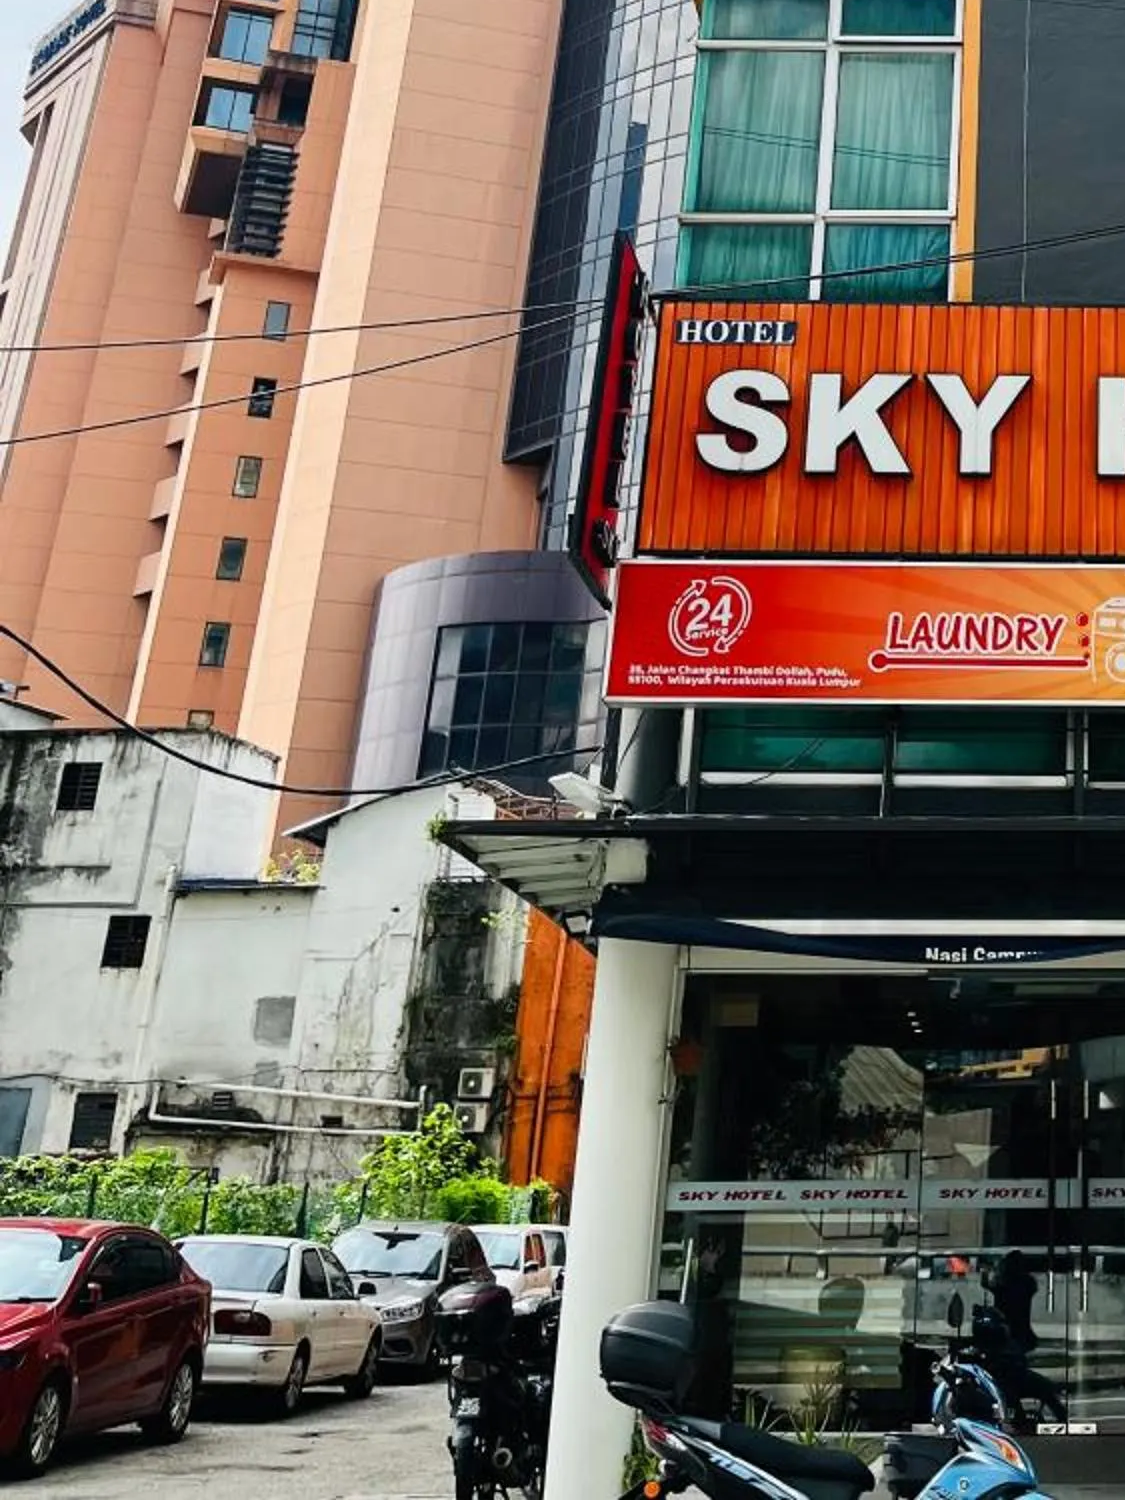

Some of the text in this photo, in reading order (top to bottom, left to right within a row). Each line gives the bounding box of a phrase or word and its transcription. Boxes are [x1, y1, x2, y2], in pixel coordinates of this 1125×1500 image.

[678, 320, 795, 343] HOTEL
[694, 367, 1032, 478] SKY
[686, 594, 733, 630] 24
[888, 612, 1066, 653] LAUNDRY
[648, 664, 676, 675] Jalan
[678, 665, 731, 677] Changkat
[667, 676, 711, 687] Wilayah
[713, 676, 784, 686] Persekutuan
[786, 677, 817, 687] Kuala
[820, 678, 862, 688] Lumpur
[925, 947, 967, 963] Nasi
[679, 1189, 787, 1201] SKY HOTEL
[800, 1189, 909, 1200] SKY HOTEL
[938, 1187, 1048, 1199] SKY HOTEL
